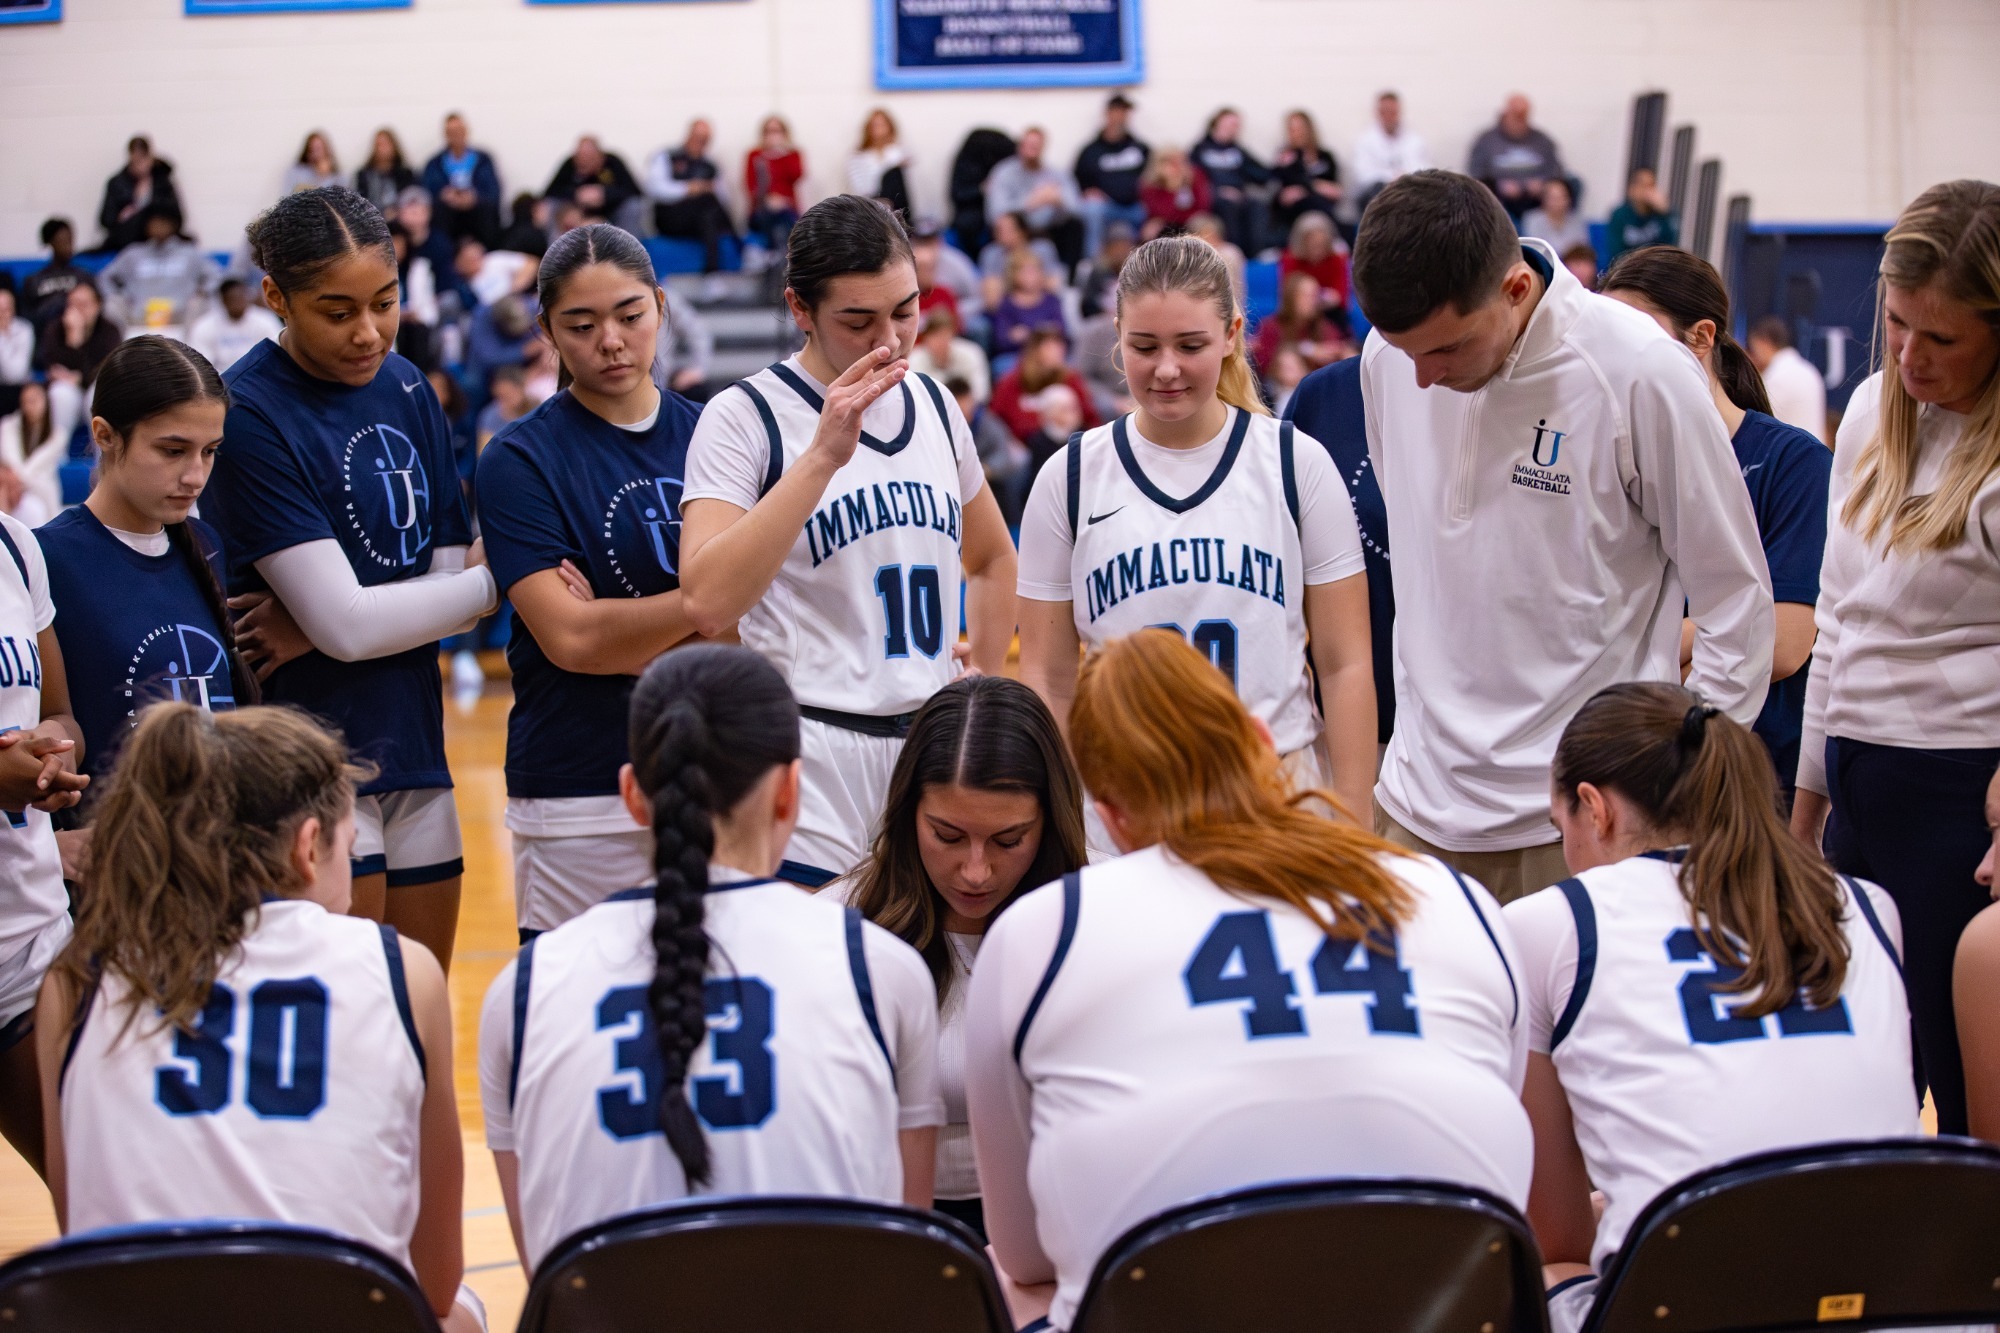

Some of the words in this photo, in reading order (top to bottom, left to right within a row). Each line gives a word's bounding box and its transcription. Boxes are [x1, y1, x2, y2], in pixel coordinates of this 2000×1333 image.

[344, 425, 375, 491] BASKETBALL
[1512, 474, 1570, 495] BASKETBALL
[1514, 465, 1571, 484] IMMACULATA
[346, 502, 397, 567] IMMAULATA
[607, 549, 641, 598] CULATA
[1086, 538, 1286, 625] IMMACULATA
[873, 563, 944, 660] 10
[125, 625, 174, 697] BASKETBALL
[1181, 903, 1424, 1042] 44
[154, 975, 331, 1122] 30
[594, 976, 777, 1143] 33
